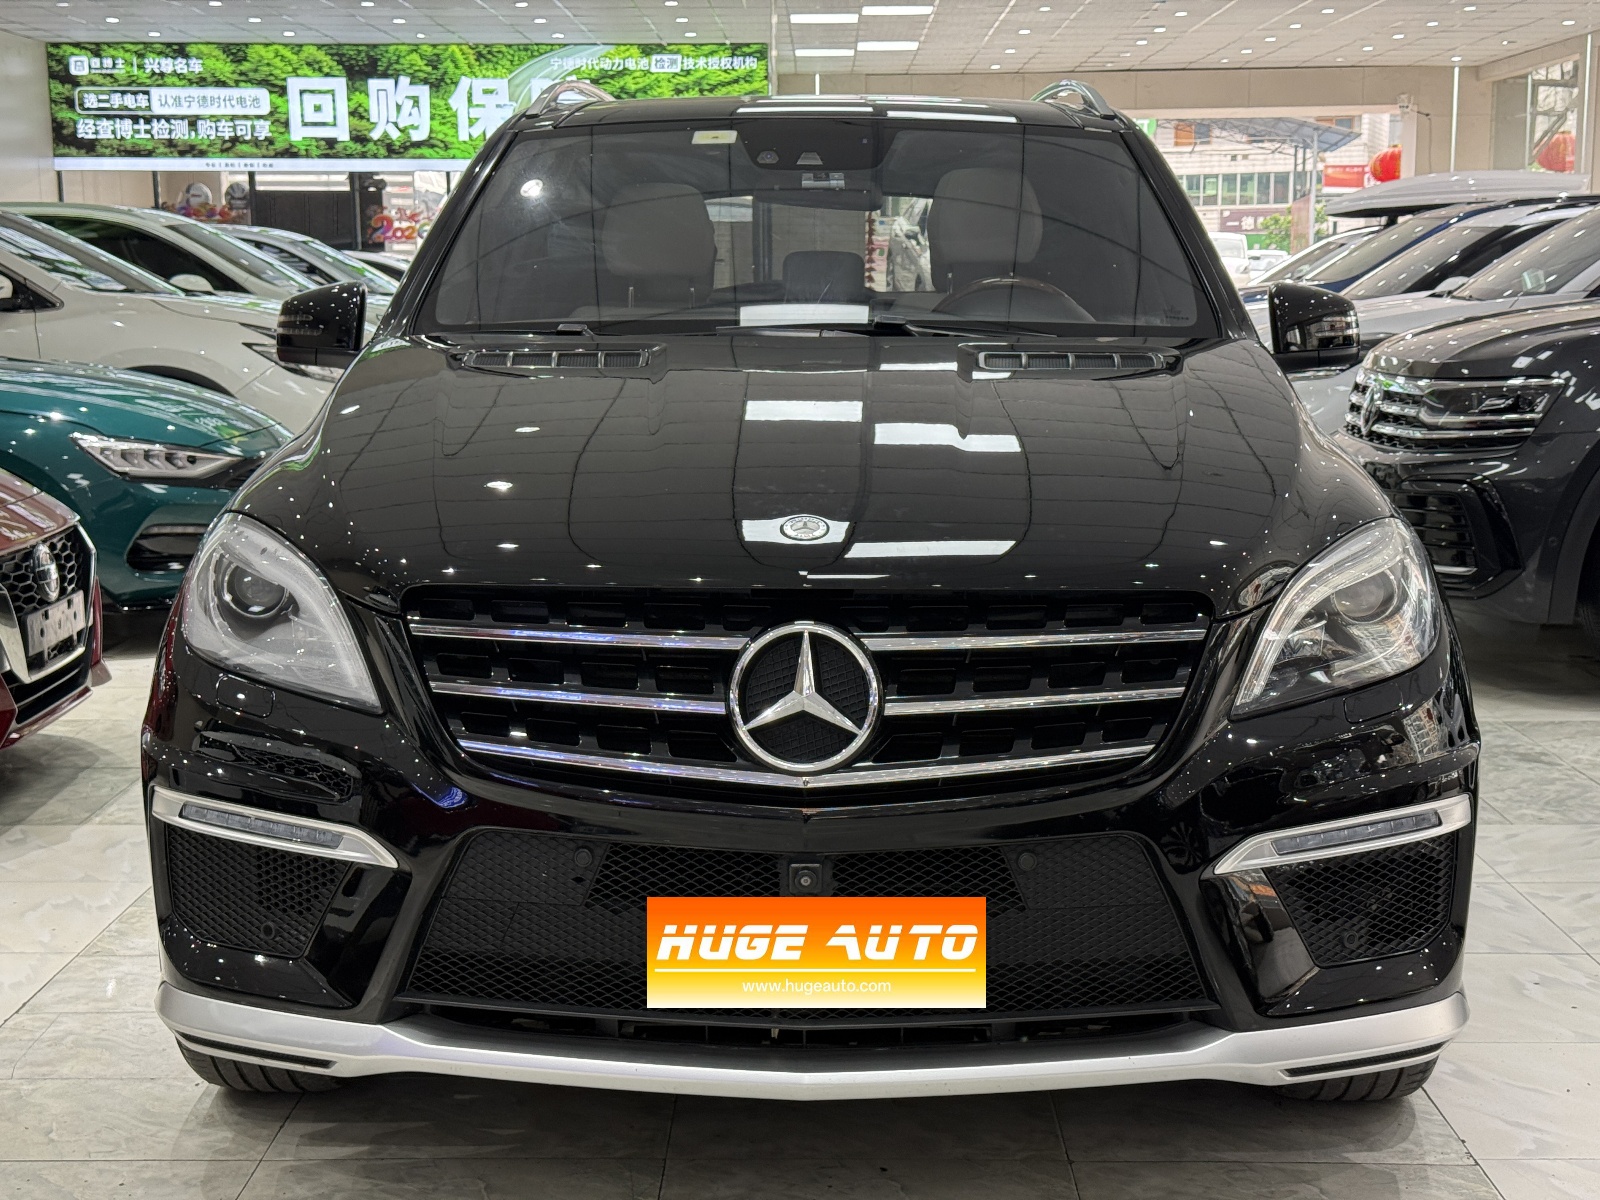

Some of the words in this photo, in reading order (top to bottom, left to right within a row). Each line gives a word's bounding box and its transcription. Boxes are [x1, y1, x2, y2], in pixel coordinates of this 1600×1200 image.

[654, 57, 679, 71] 检测
[683, 57, 758, 71] 技术授权机构
[158, 94, 261, 109] 认准宁德时代电池
